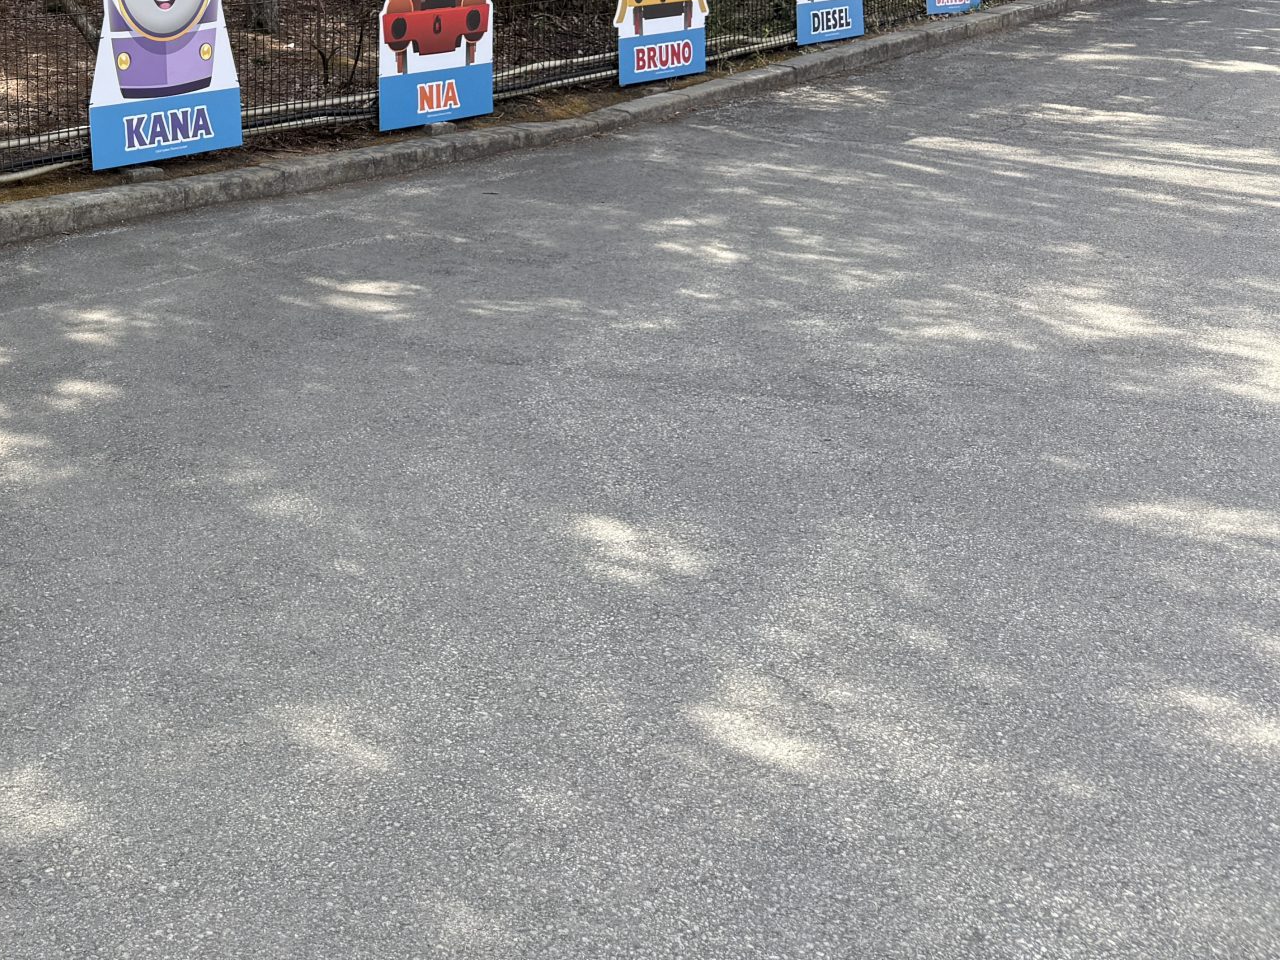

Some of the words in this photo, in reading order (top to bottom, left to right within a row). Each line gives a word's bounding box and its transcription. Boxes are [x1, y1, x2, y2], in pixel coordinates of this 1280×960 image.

[811, 6, 852, 35] DIESEL
[634, 39, 693, 73] BRUNO
[417, 79, 460, 114] NIA
[123, 105, 214, 151] KANA
